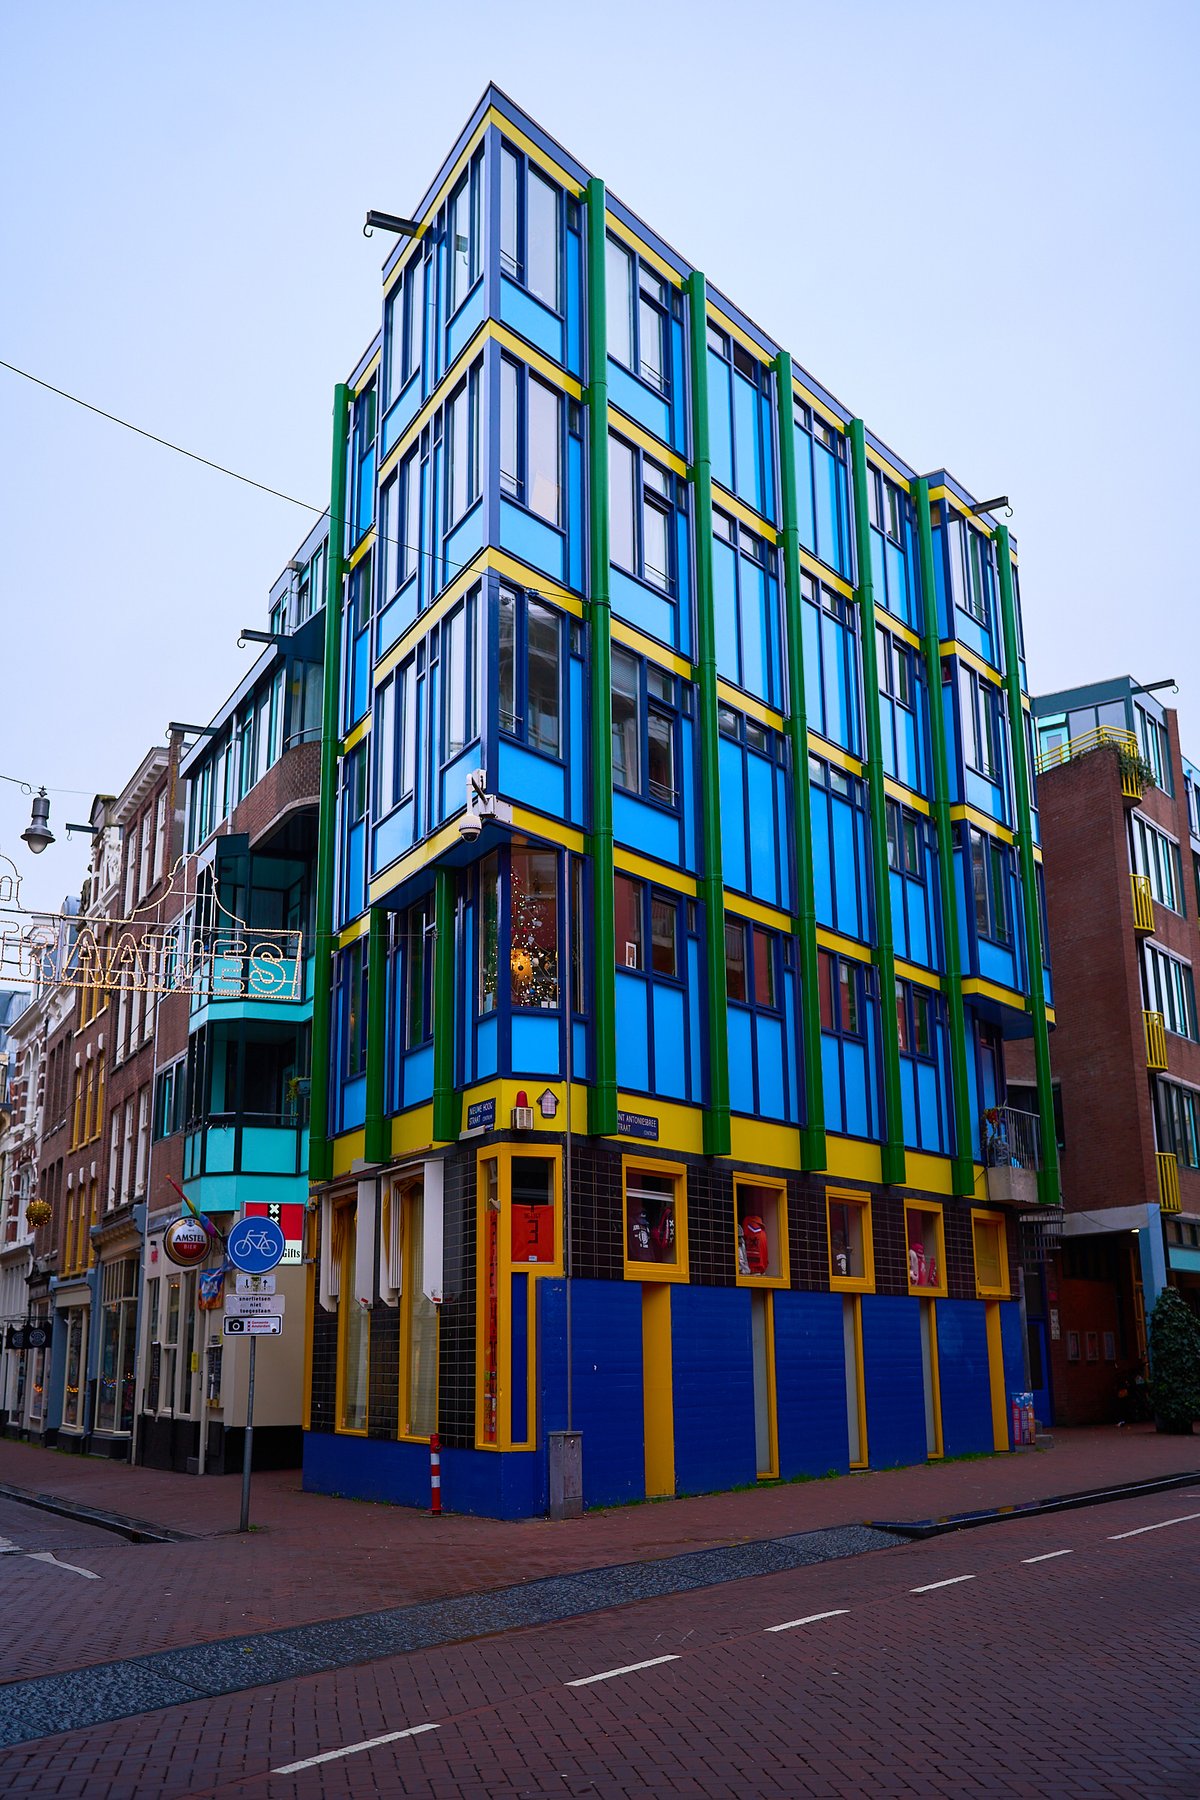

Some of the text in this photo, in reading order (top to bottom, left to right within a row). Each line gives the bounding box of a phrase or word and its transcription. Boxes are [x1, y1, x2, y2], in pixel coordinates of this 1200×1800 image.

[469, 1104, 482, 1115] NIEUWE
[469, 1114, 481, 1126] STRAAT
[626, 1115, 657, 1128] ANTONIESBREE
[527, 1219, 539, 1244] 3
[175, 1233, 205, 1242] AMSTEL
[283, 1248, 301, 1259] Gifts
